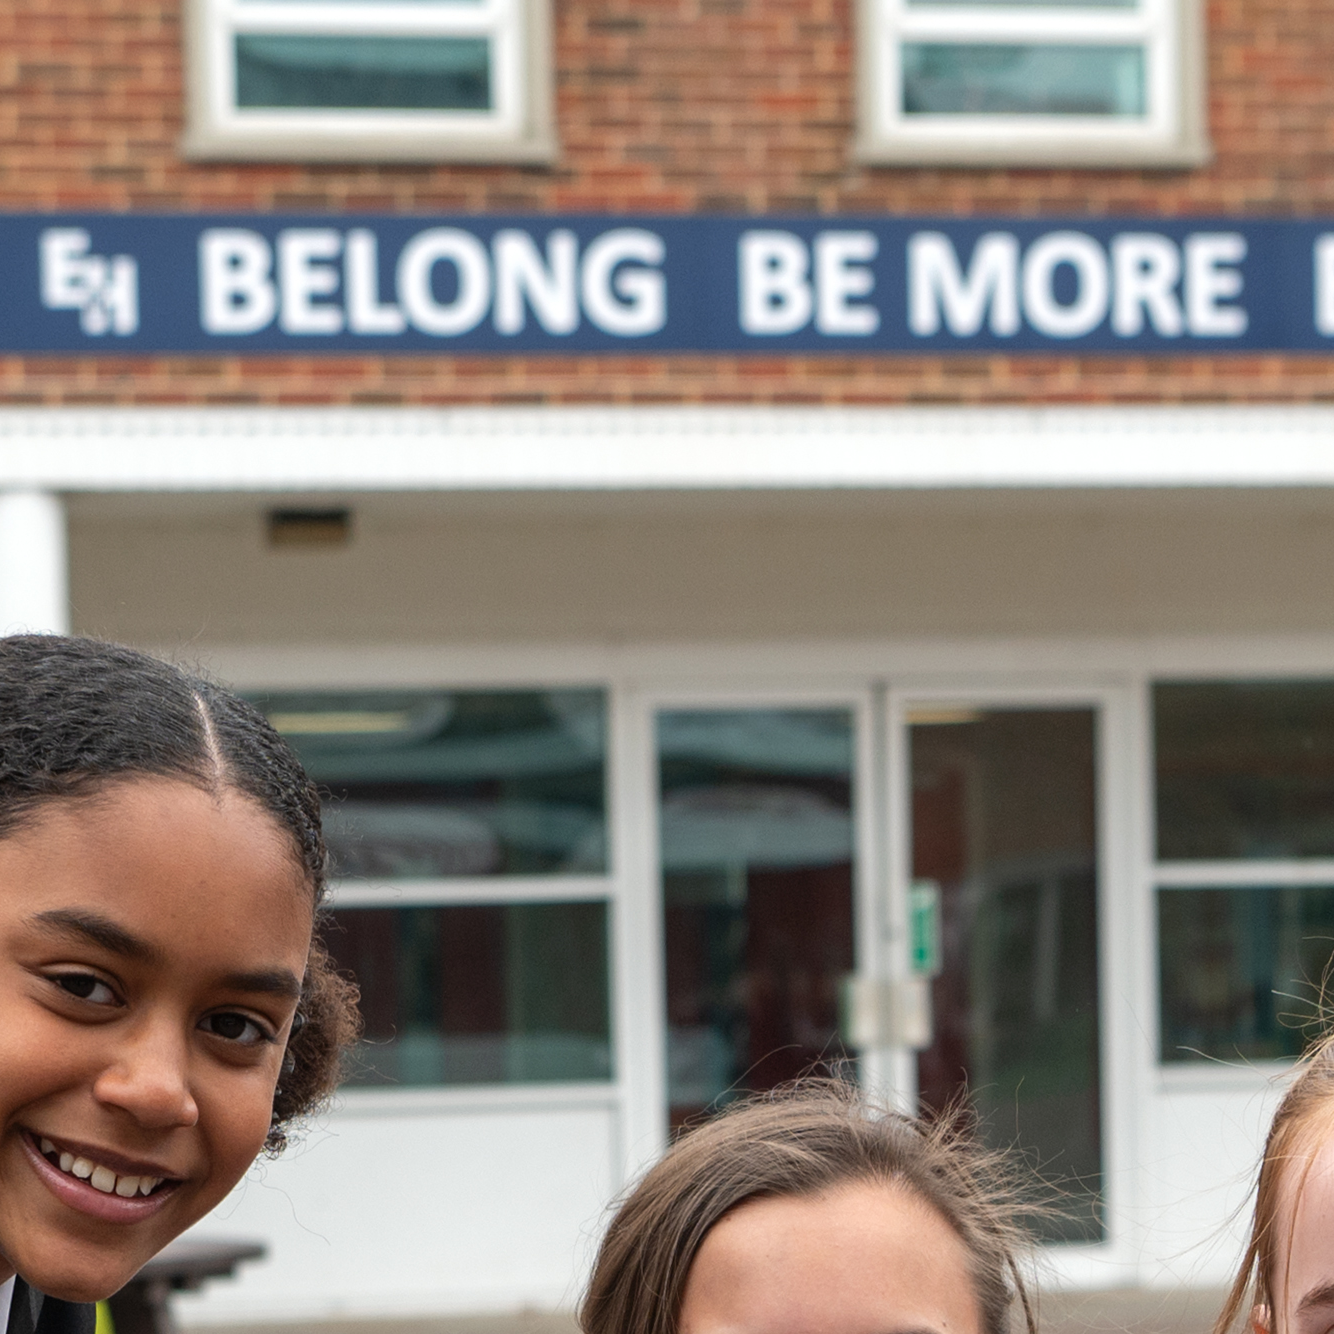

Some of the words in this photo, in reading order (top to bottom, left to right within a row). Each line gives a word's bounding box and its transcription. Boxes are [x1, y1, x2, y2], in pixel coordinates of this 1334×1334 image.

[200, 228, 665, 335] BELONG
[739, 231, 879, 335] BE
[907, 232, 1247, 336] MORE
